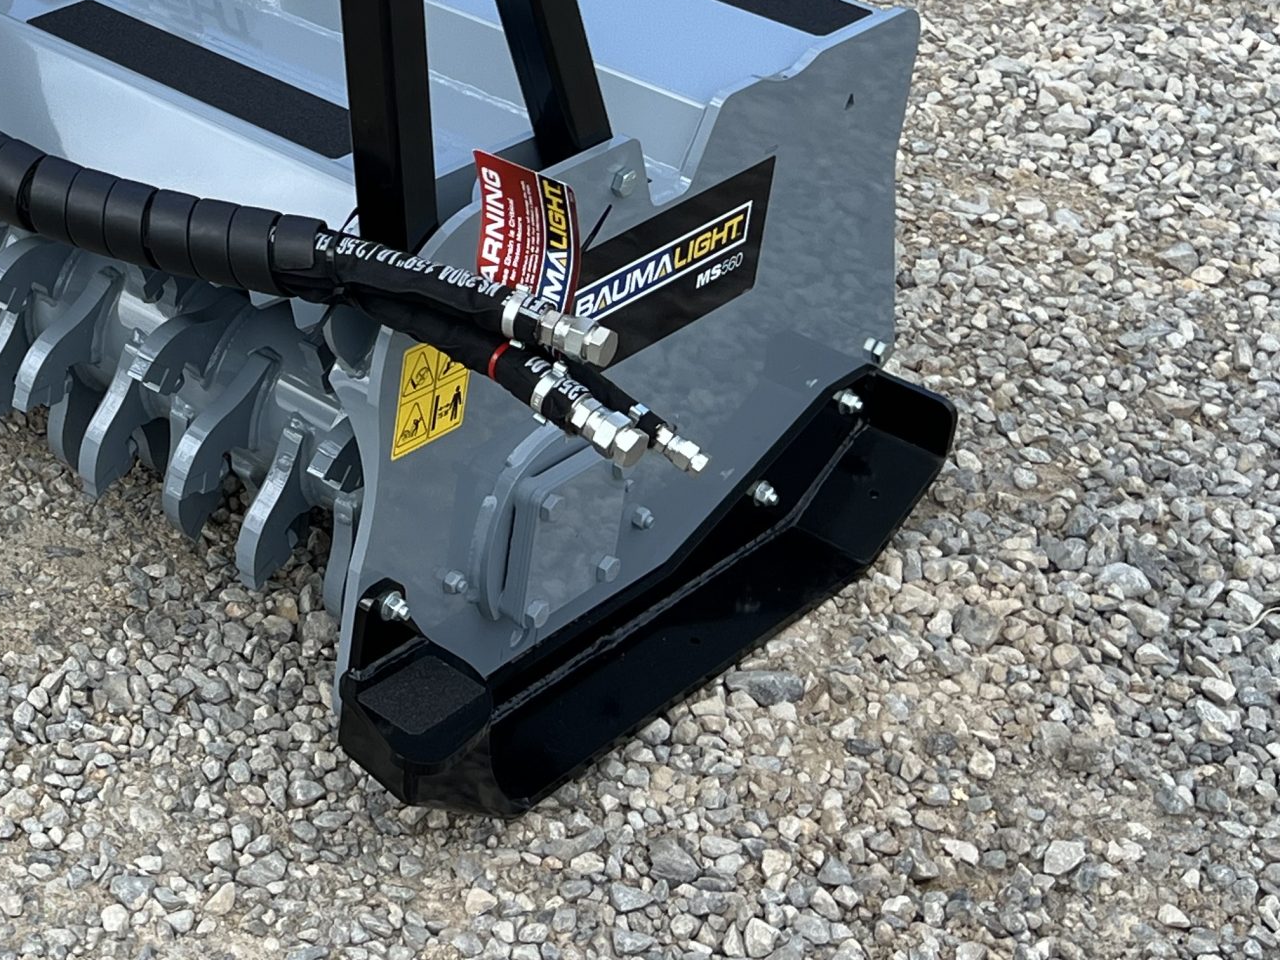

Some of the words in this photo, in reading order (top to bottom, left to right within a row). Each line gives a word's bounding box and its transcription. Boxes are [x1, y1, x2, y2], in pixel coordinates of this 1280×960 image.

[480, 167, 505, 283] ARNING
[576, 214, 744, 318] BAUMALIGHT
[696, 252, 744, 289] MS560
